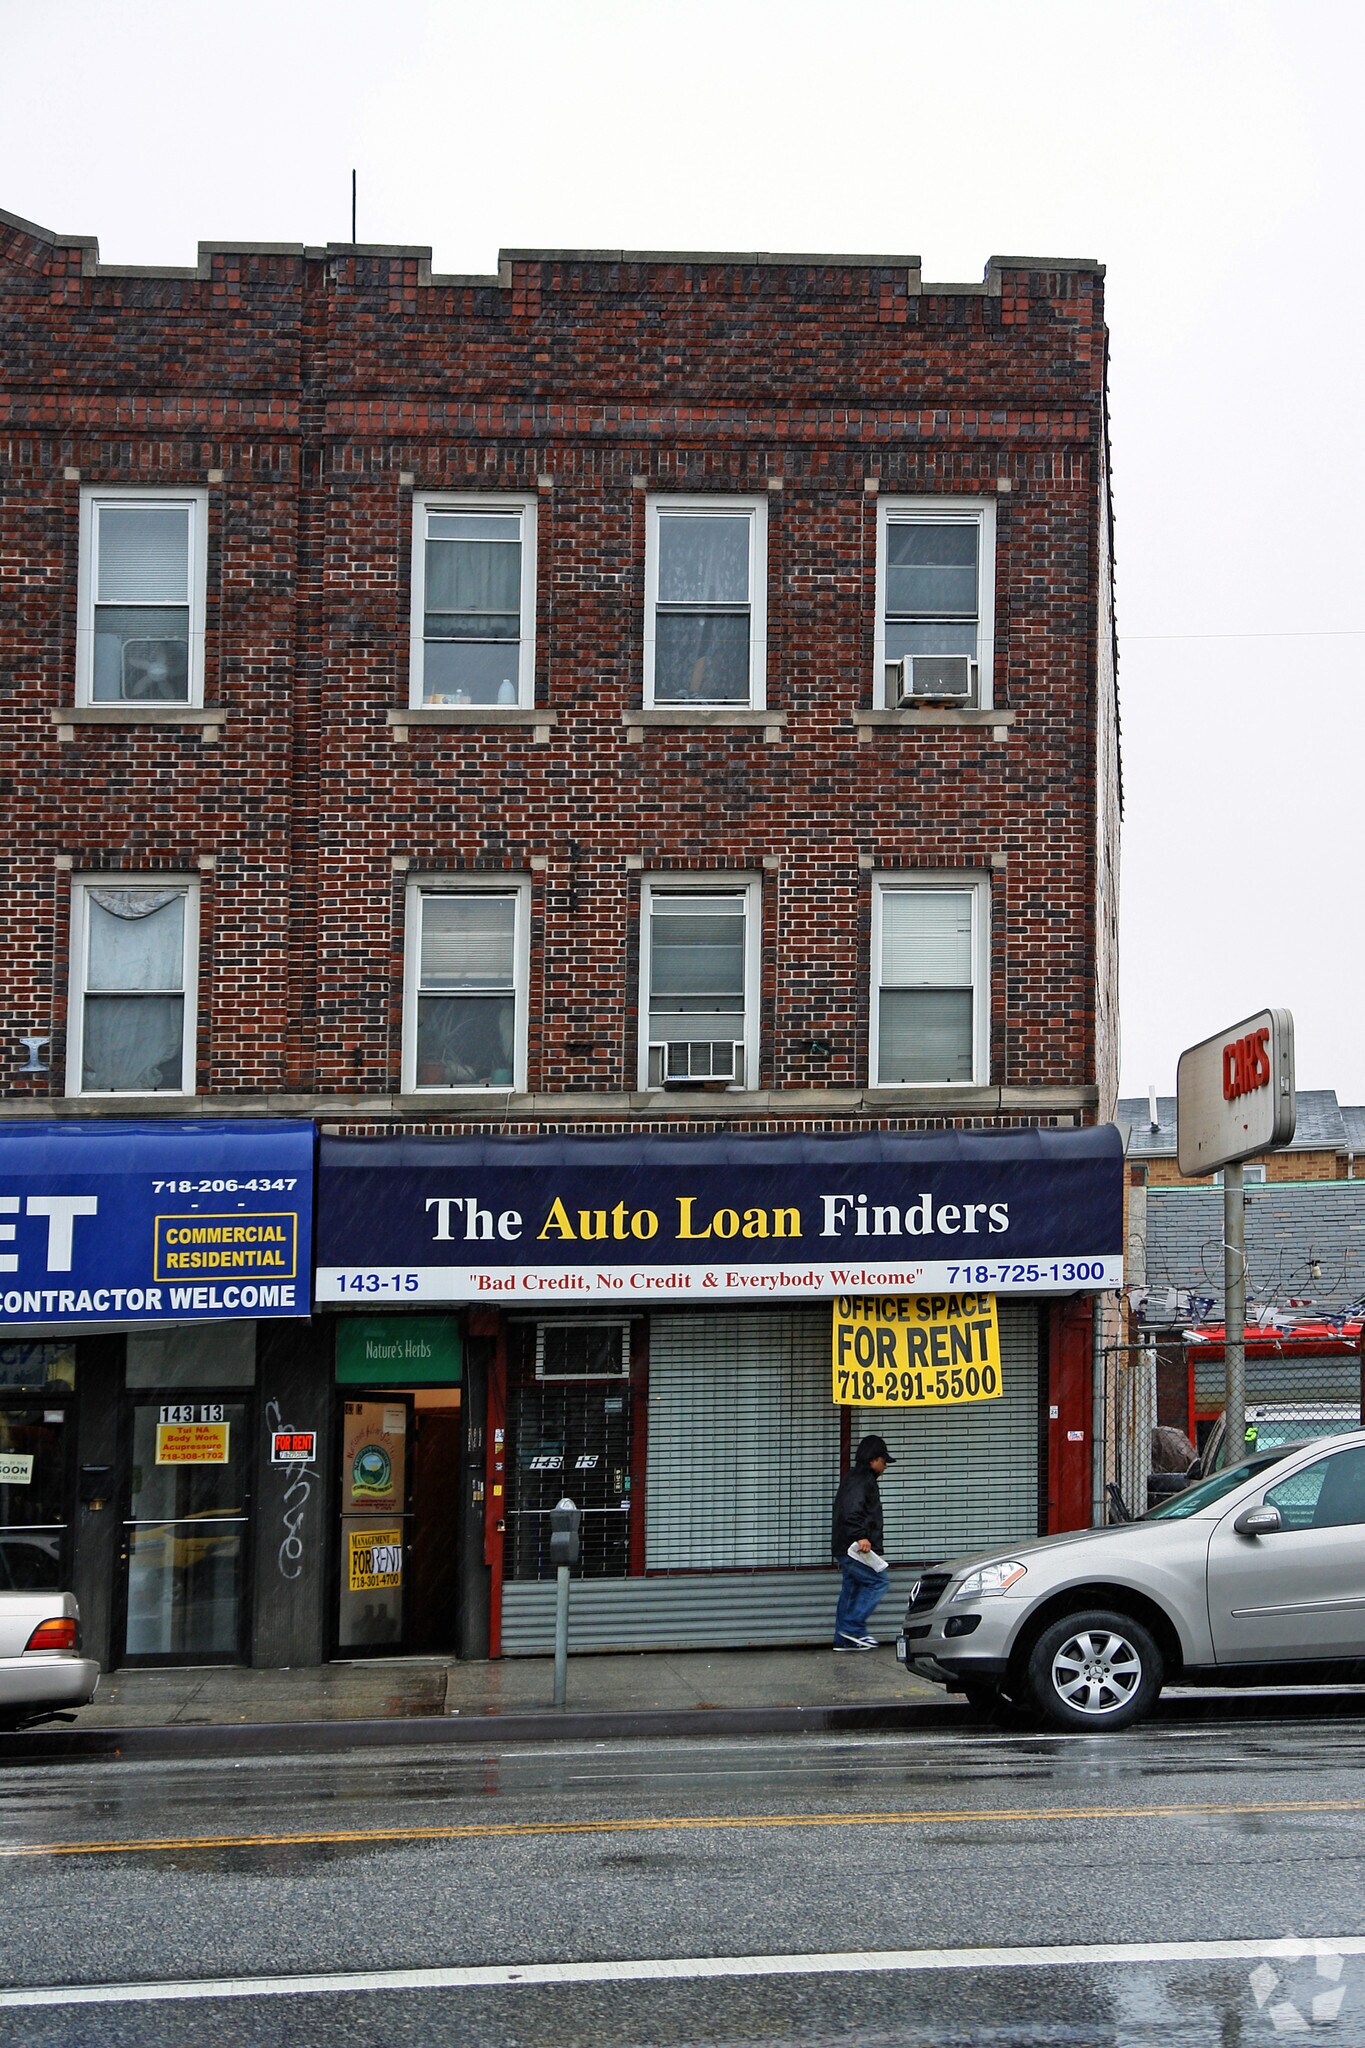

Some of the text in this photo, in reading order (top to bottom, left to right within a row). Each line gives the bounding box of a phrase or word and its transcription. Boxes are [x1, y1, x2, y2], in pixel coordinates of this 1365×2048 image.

[1223, 1028, 1270, 1101] CARS
[152, 1179, 297, 1193] 718-206-4347
[425, 1194, 1010, 1241] The Auto Loan Finders
[166, 1226, 286, 1245] COMMERCIAL
[167, 1250, 285, 1269] RESIDENTIAL
[470, 1268, 923, 1292] "Bad Credit, No Credit & Everybody Welcome"
[947, 1262, 1105, 1284] 718-725-1300
[337, 1274, 419, 1292] 143-15
[0, 1285, 296, 1313] ONTRACTOR WELCOME
[838, 1292, 992, 1322] OFFICE SPACE
[366, 1339, 431, 1358] Nature's Herbs
[838, 1319, 992, 1368] FOR RENT
[838, 1365, 996, 1400] 718-291-5500
[162, 1405, 222, 1422] 143 13
[163, 1443, 222, 1451] Acupressure
[275, 1435, 313, 1451] FOR RENT
[161, 1452, 223, 1460] 718-308-1702
[352, 1535, 390, 1547] MANAGEMENT
[353, 1550, 372, 1575] FOR
[372, 1546, 401, 1573] RENT
[352, 1573, 399, 1588] 718-301-4700
